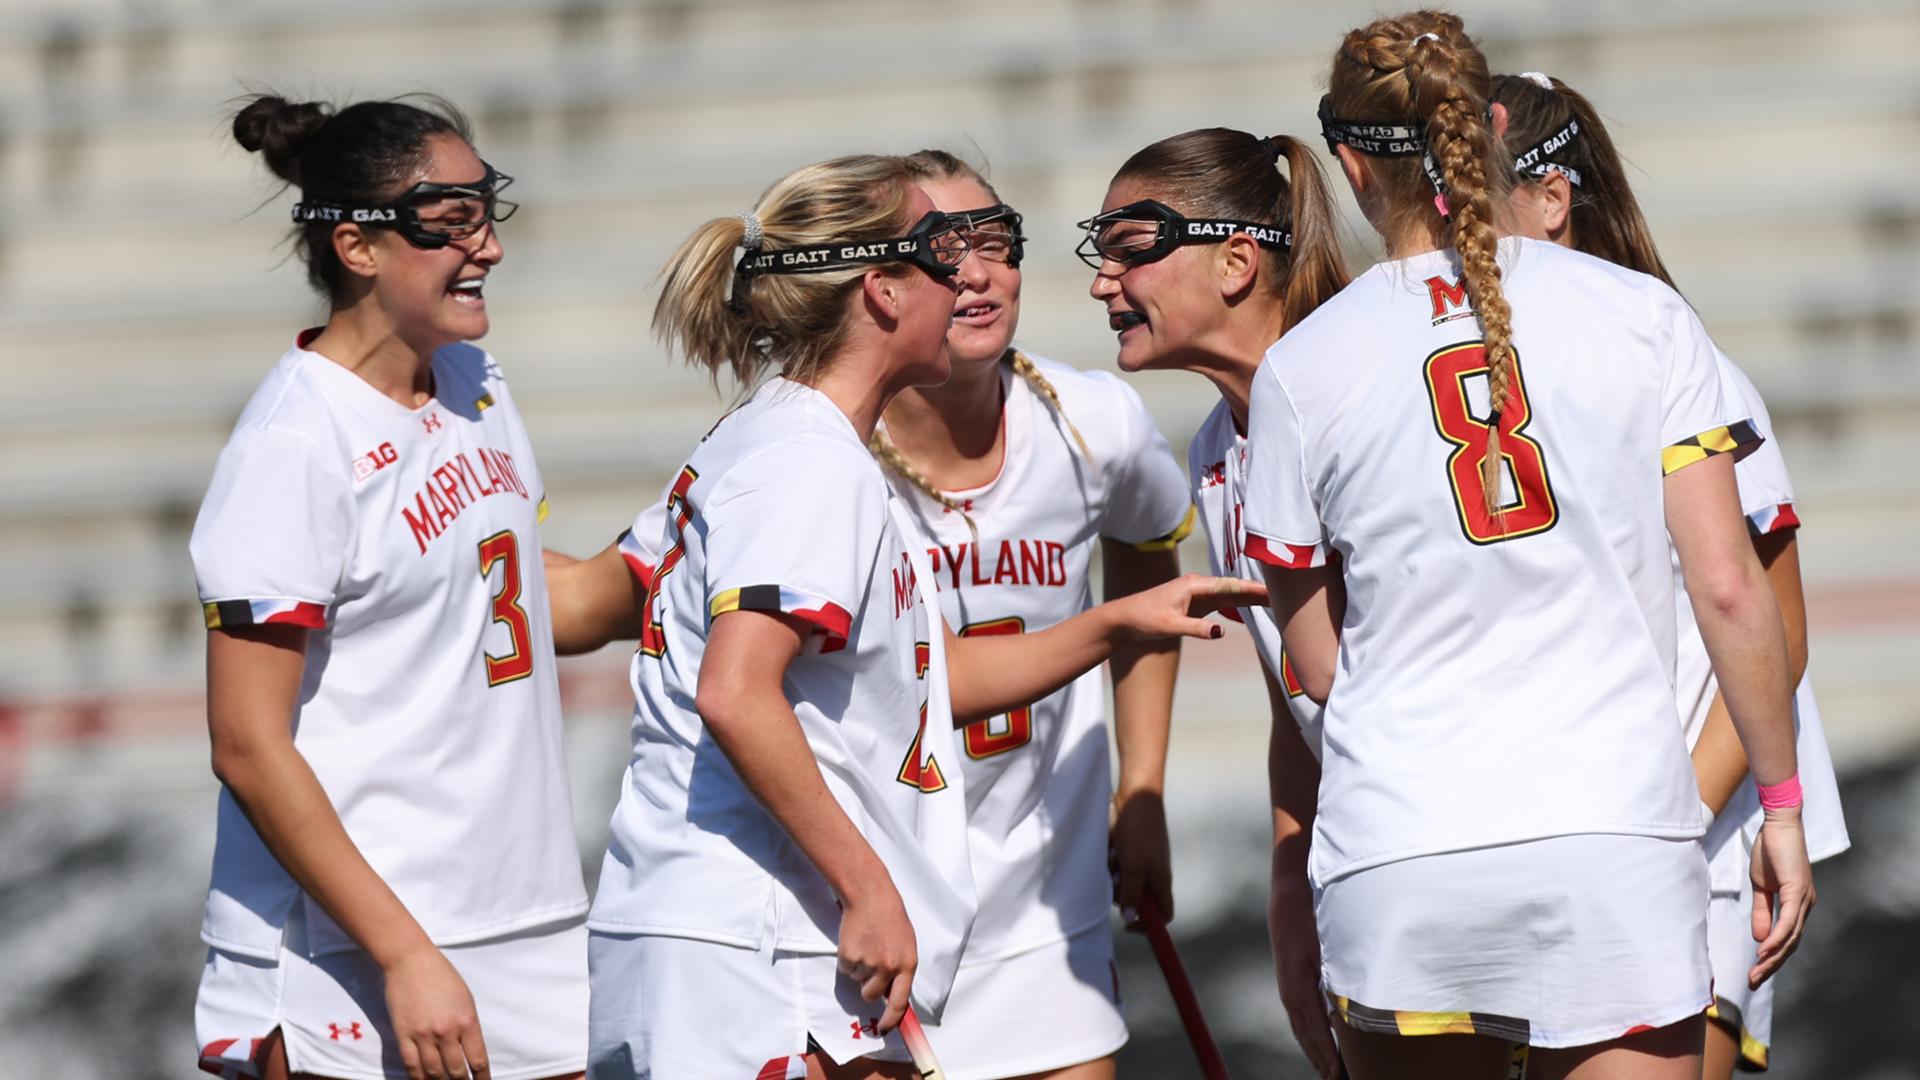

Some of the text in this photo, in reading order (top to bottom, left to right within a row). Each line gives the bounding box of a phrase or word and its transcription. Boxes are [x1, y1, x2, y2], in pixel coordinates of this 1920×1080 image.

[1348, 136, 1381, 152] GAIT
[1514, 147, 1540, 171] AIT
[1542, 128, 1571, 155] GAIT
[782, 249, 830, 265] GAIT
[841, 243, 888, 259] GAIT
[1187, 222, 1237, 236] GAIT
[1245, 226, 1282, 243] GAIT
[1422, 339, 1560, 546] 8
[401, 447, 530, 558] MARYLAND
[477, 528, 533, 688] 3
